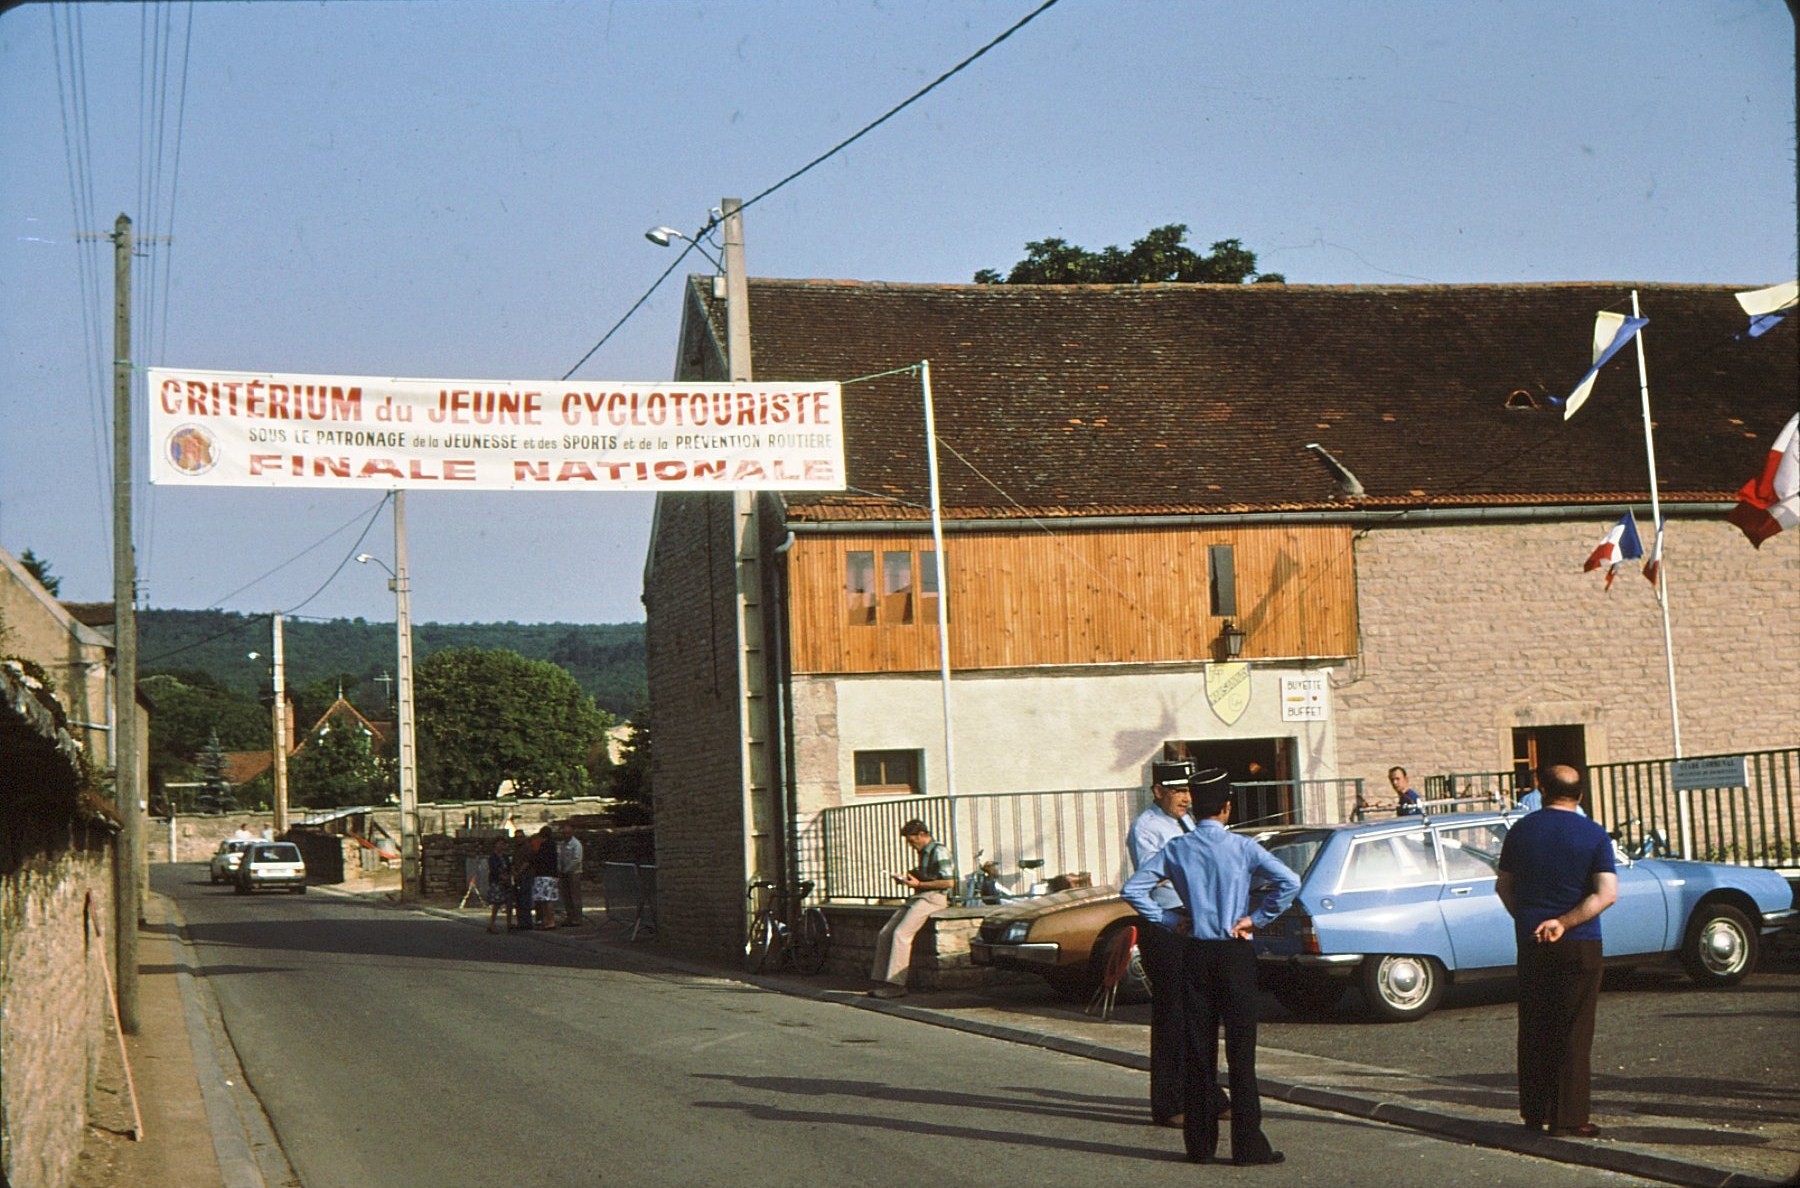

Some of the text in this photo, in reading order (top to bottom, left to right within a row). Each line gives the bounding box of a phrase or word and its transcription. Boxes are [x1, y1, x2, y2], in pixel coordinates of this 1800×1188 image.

[161, 379, 830, 426] CRITÉRIUM du JEUNE CYCLOTOURISTE
[249, 429, 287, 443] SOUS
[295, 430, 309, 444] LE
[316, 430, 405, 447] PATRONAGE
[444, 434, 517, 449] JEUNESSE
[563, 435, 617, 450] SPORTS
[623, 438, 635, 449] et
[639, 437, 651, 449] de
[658, 437, 667, 449] la
[676, 434, 760, 449] PRÉVENTION
[768, 433, 832, 448] ROUTIÈRE
[249, 454, 835, 481] FINALE NATIONALE
[1288, 706, 1321, 716] BUFFET
